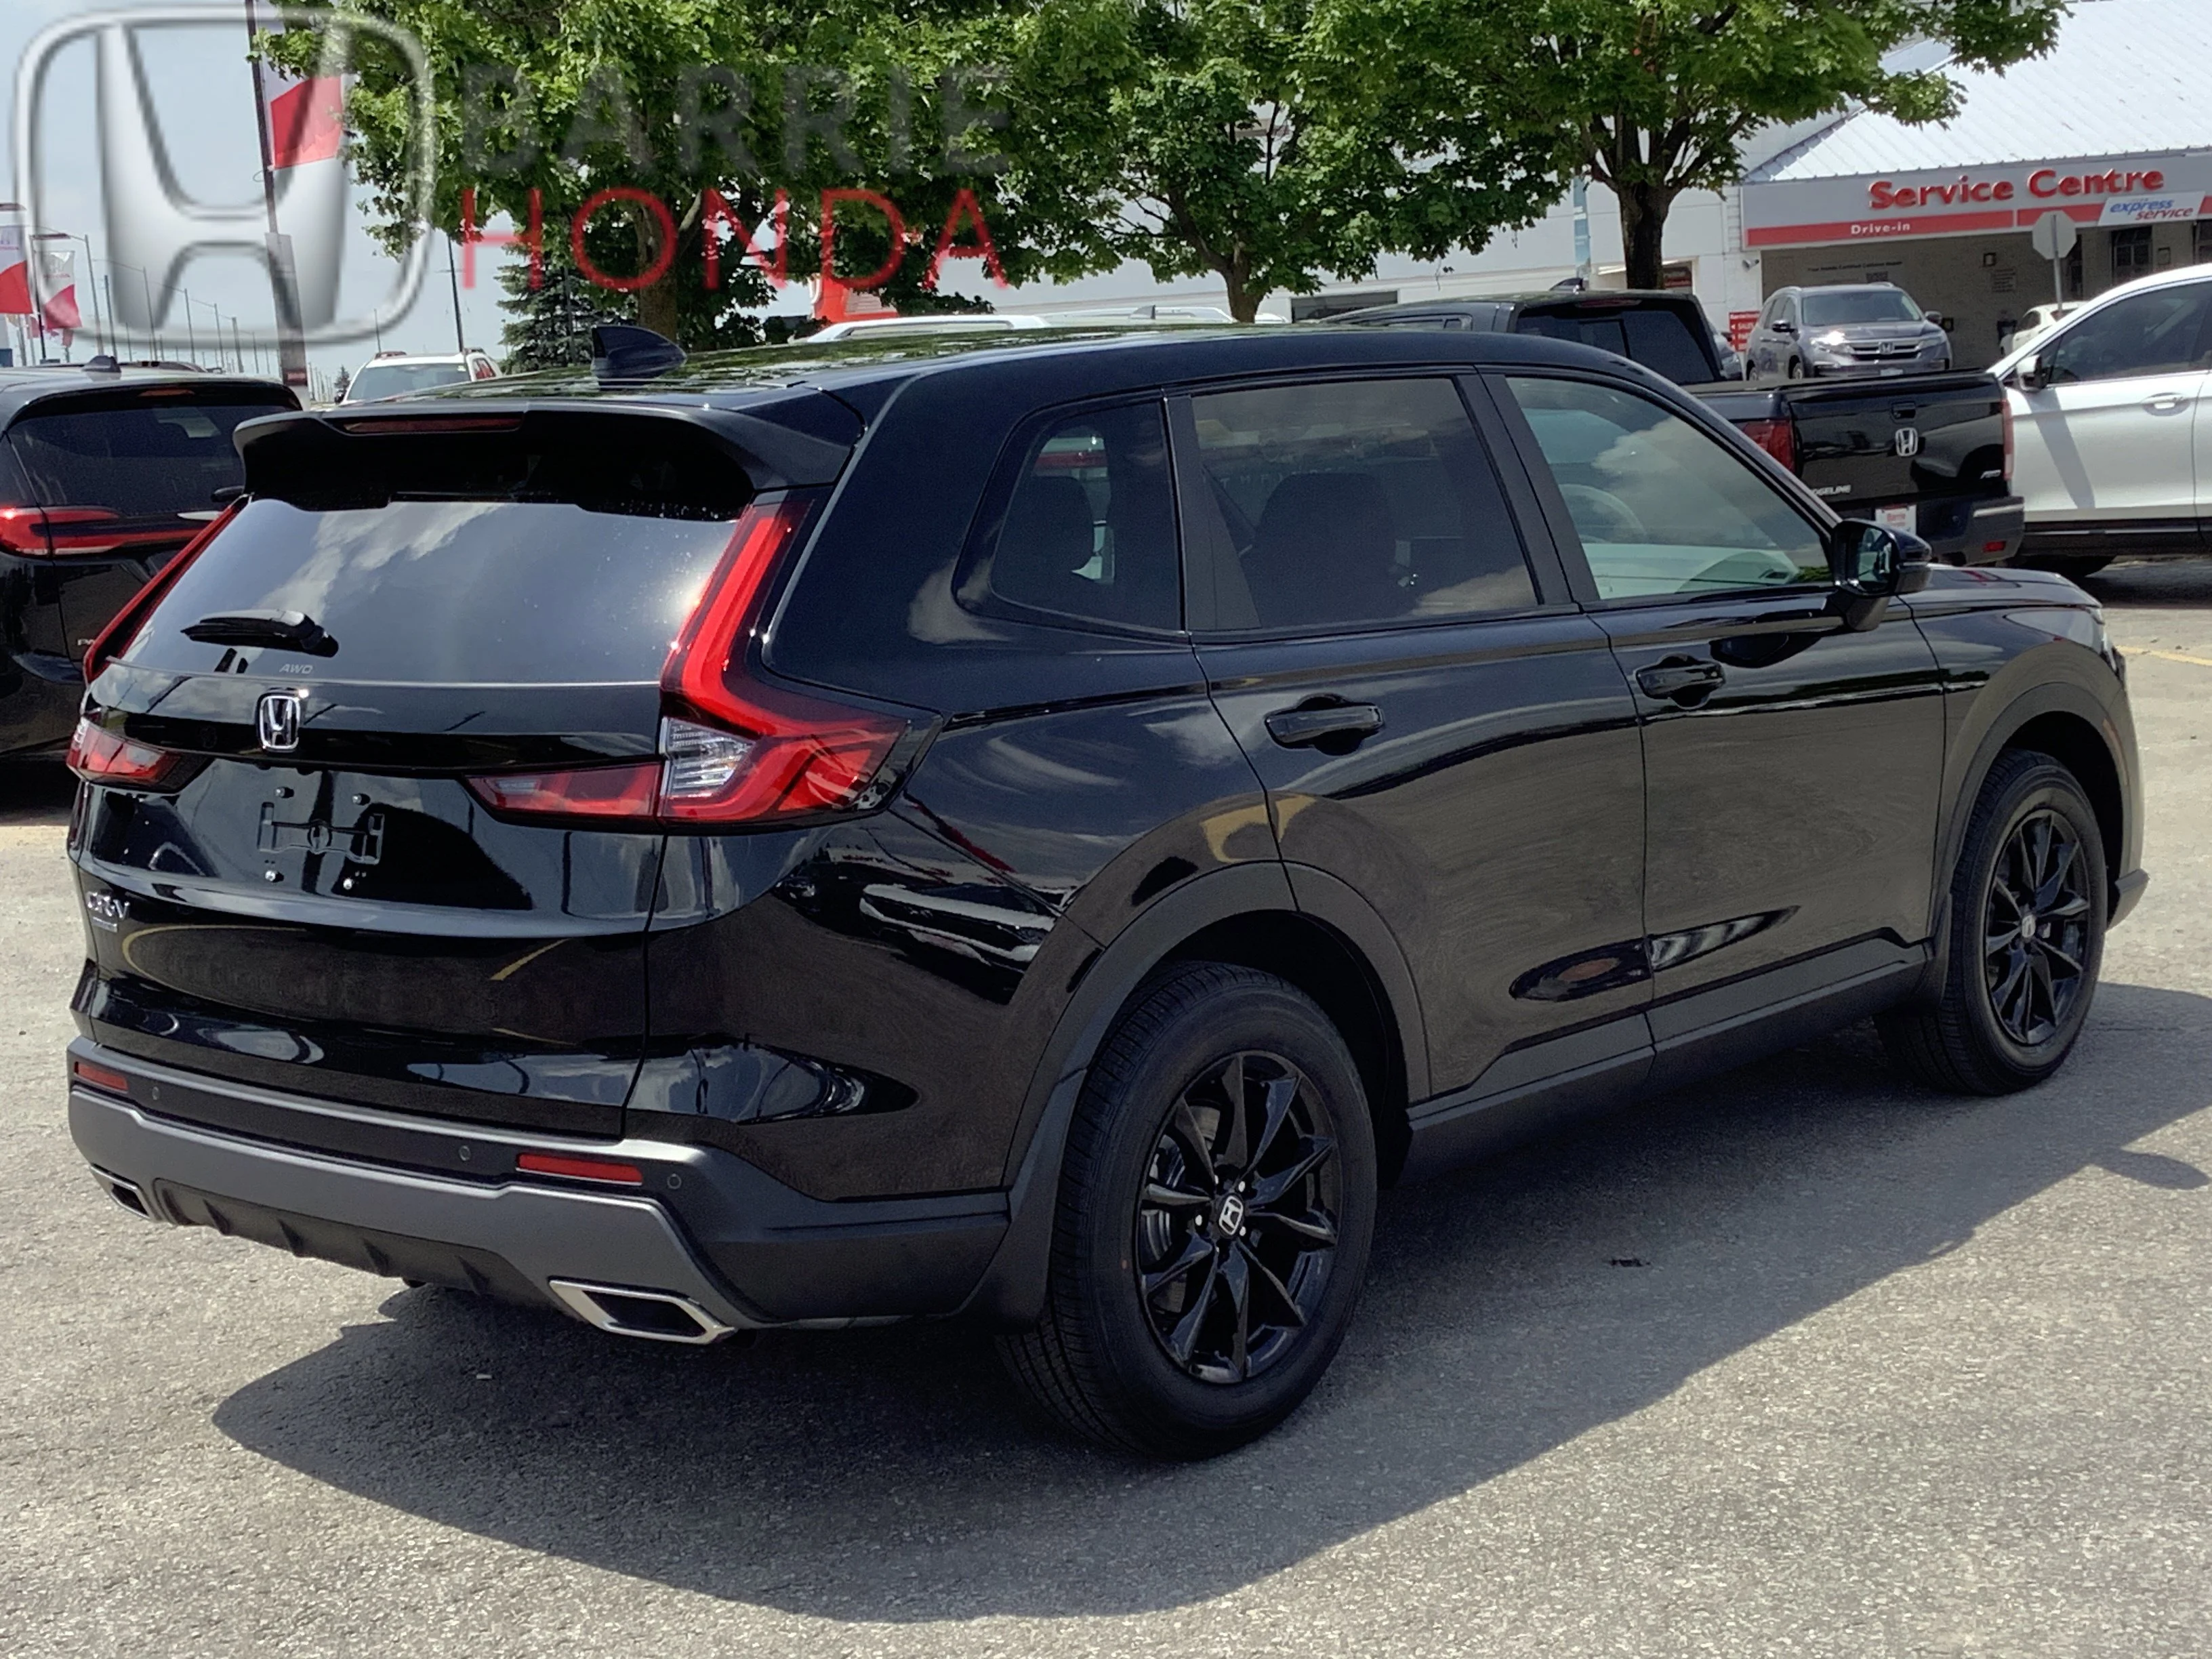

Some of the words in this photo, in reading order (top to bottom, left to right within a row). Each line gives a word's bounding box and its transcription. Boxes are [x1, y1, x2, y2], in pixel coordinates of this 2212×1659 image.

[1868, 175, 2014, 210] Service
[2027, 168, 2165, 198] Centre
[2110, 199, 2175, 215] express
[2135, 207, 2194, 221] service
[1851, 220, 1911, 235] Drive-in
[279, 663, 313, 674] AWD
